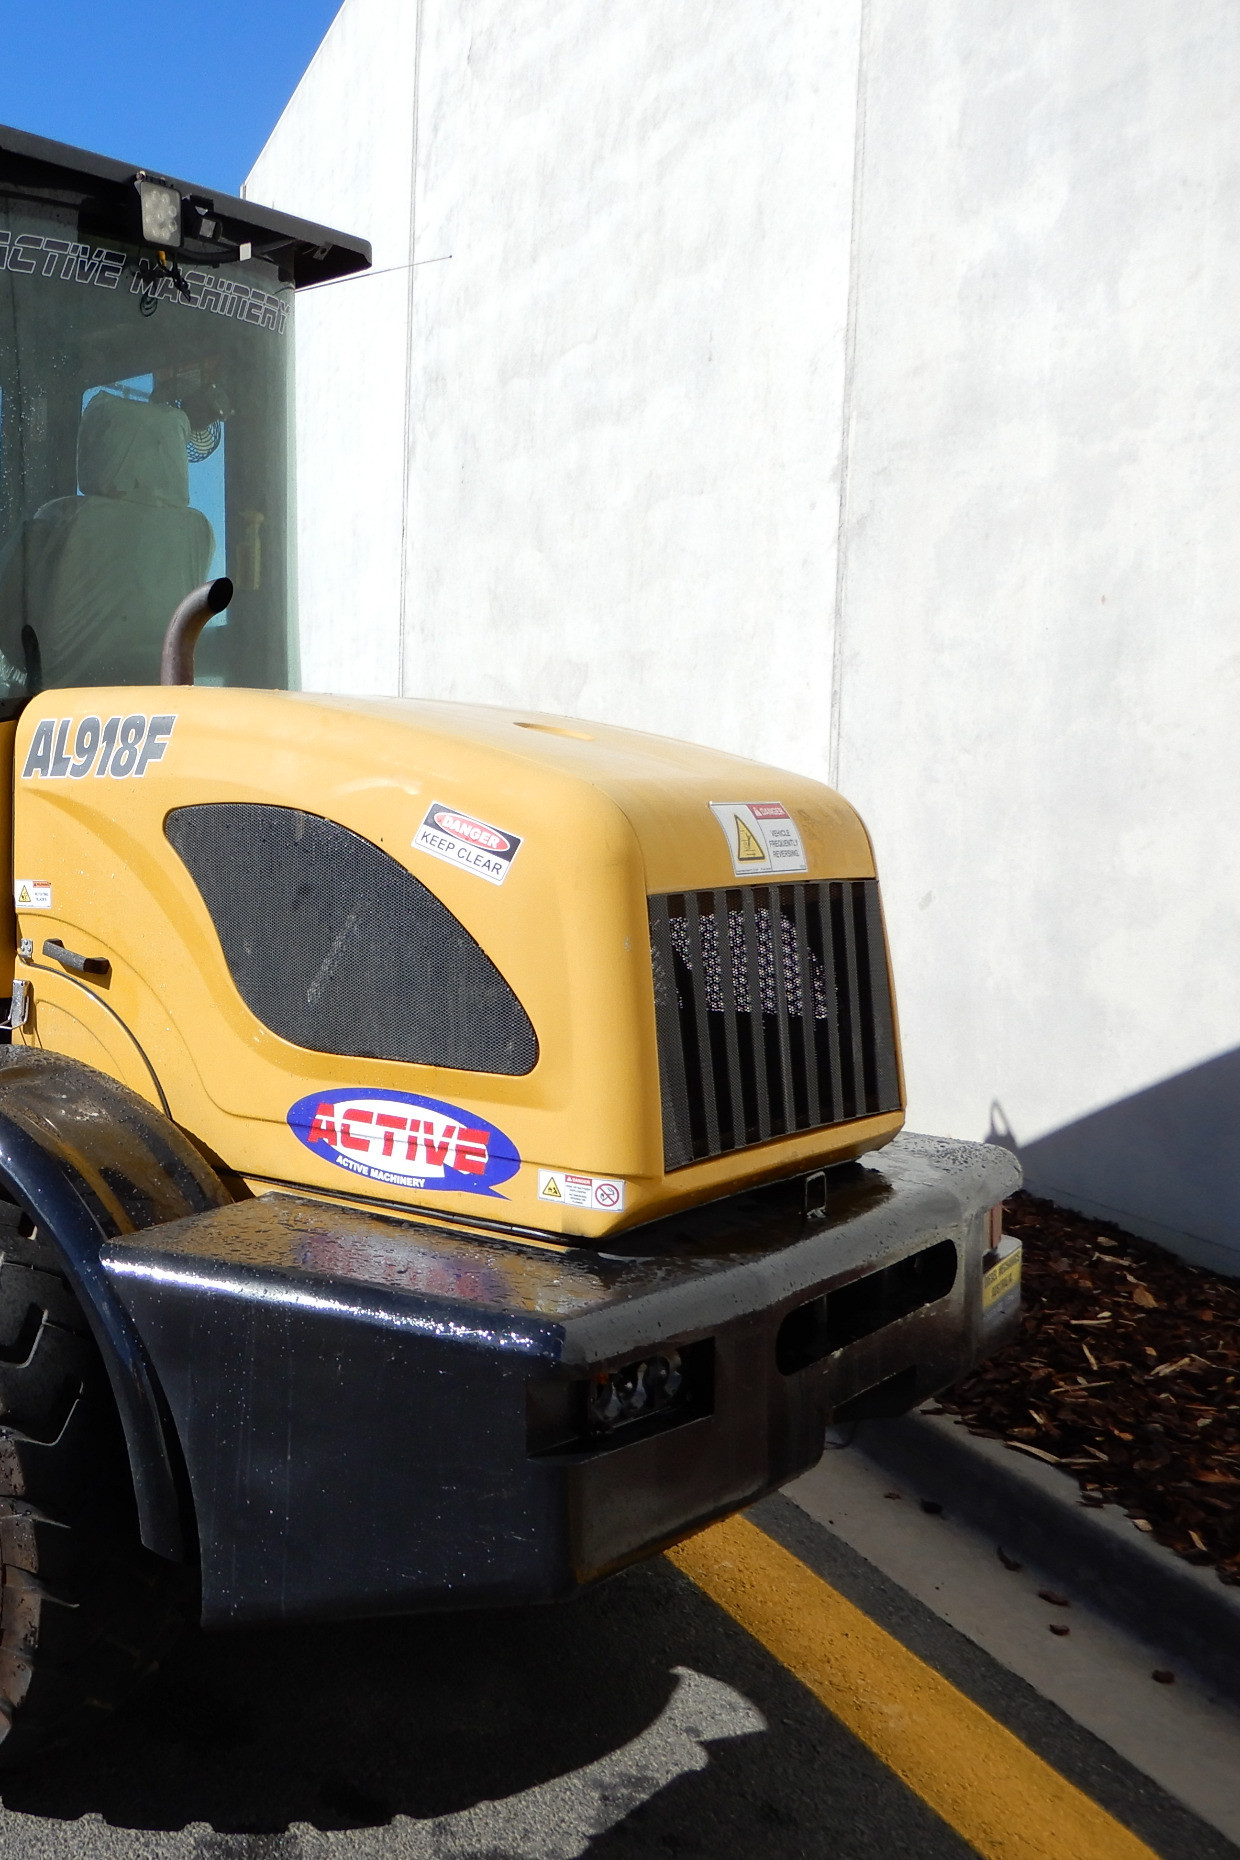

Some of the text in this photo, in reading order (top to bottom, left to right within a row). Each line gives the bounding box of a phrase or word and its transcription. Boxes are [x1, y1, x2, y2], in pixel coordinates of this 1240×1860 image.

[130, 258, 292, 335] MACHINERY
[21, 714, 178, 780] AL918F
[420, 830, 503, 875] KEEP CLEAR
[442, 814, 501, 849] DANGER
[307, 1102, 490, 1175] ACTIVE
[335, 1154, 426, 1188] ACTIVE MACHINERY
